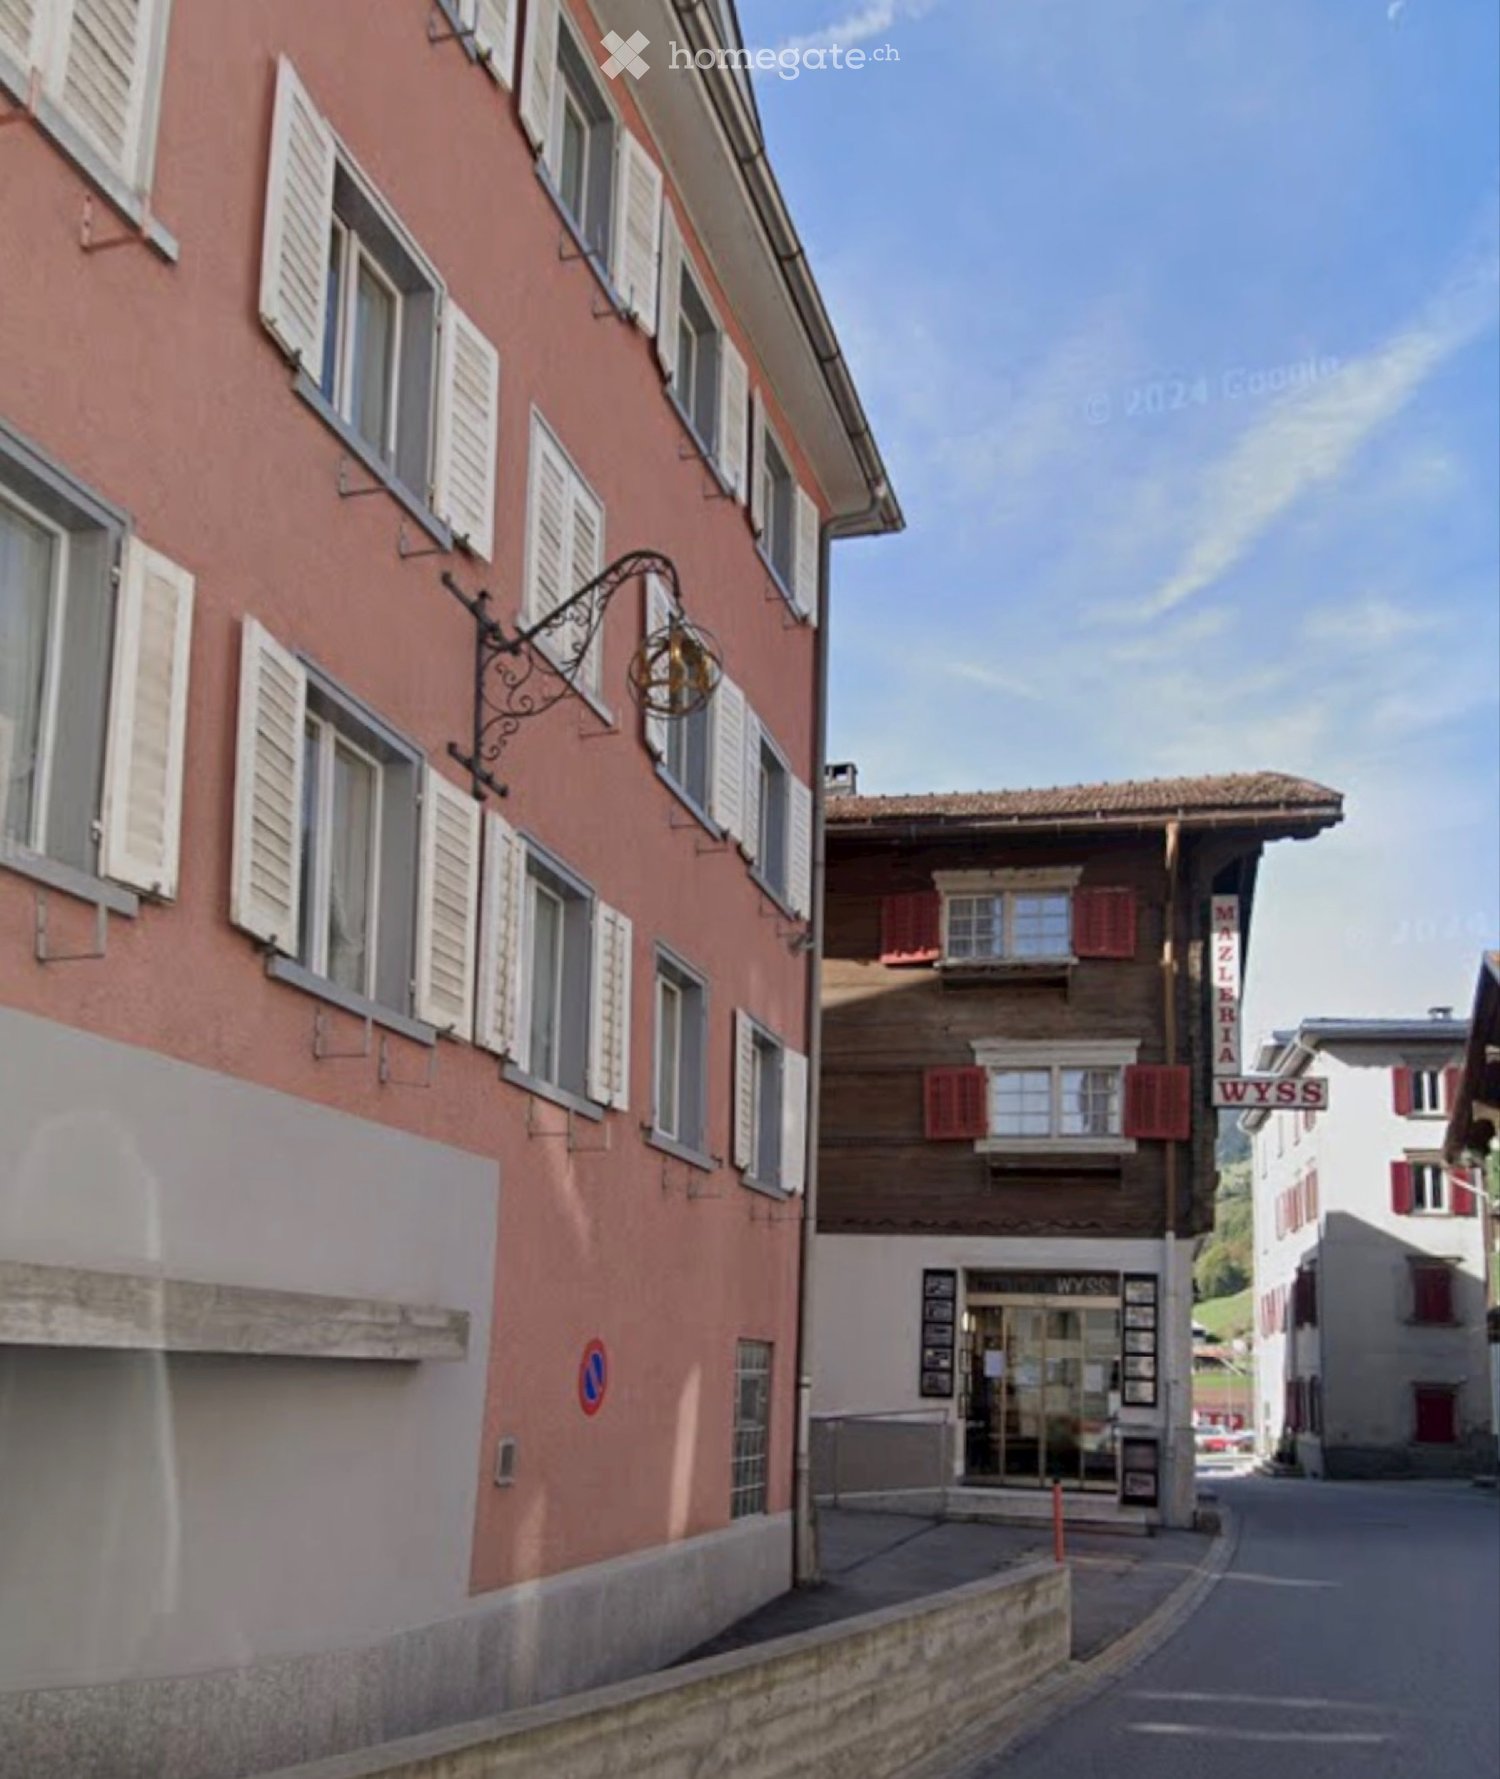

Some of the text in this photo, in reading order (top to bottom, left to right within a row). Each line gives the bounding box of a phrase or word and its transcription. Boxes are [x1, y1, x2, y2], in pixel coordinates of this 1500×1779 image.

[1215, 905, 1236, 1064] MAZLERIA
[1219, 1082, 1322, 1104] WYSS
[1057, 1277, 1111, 1295] WYSS
